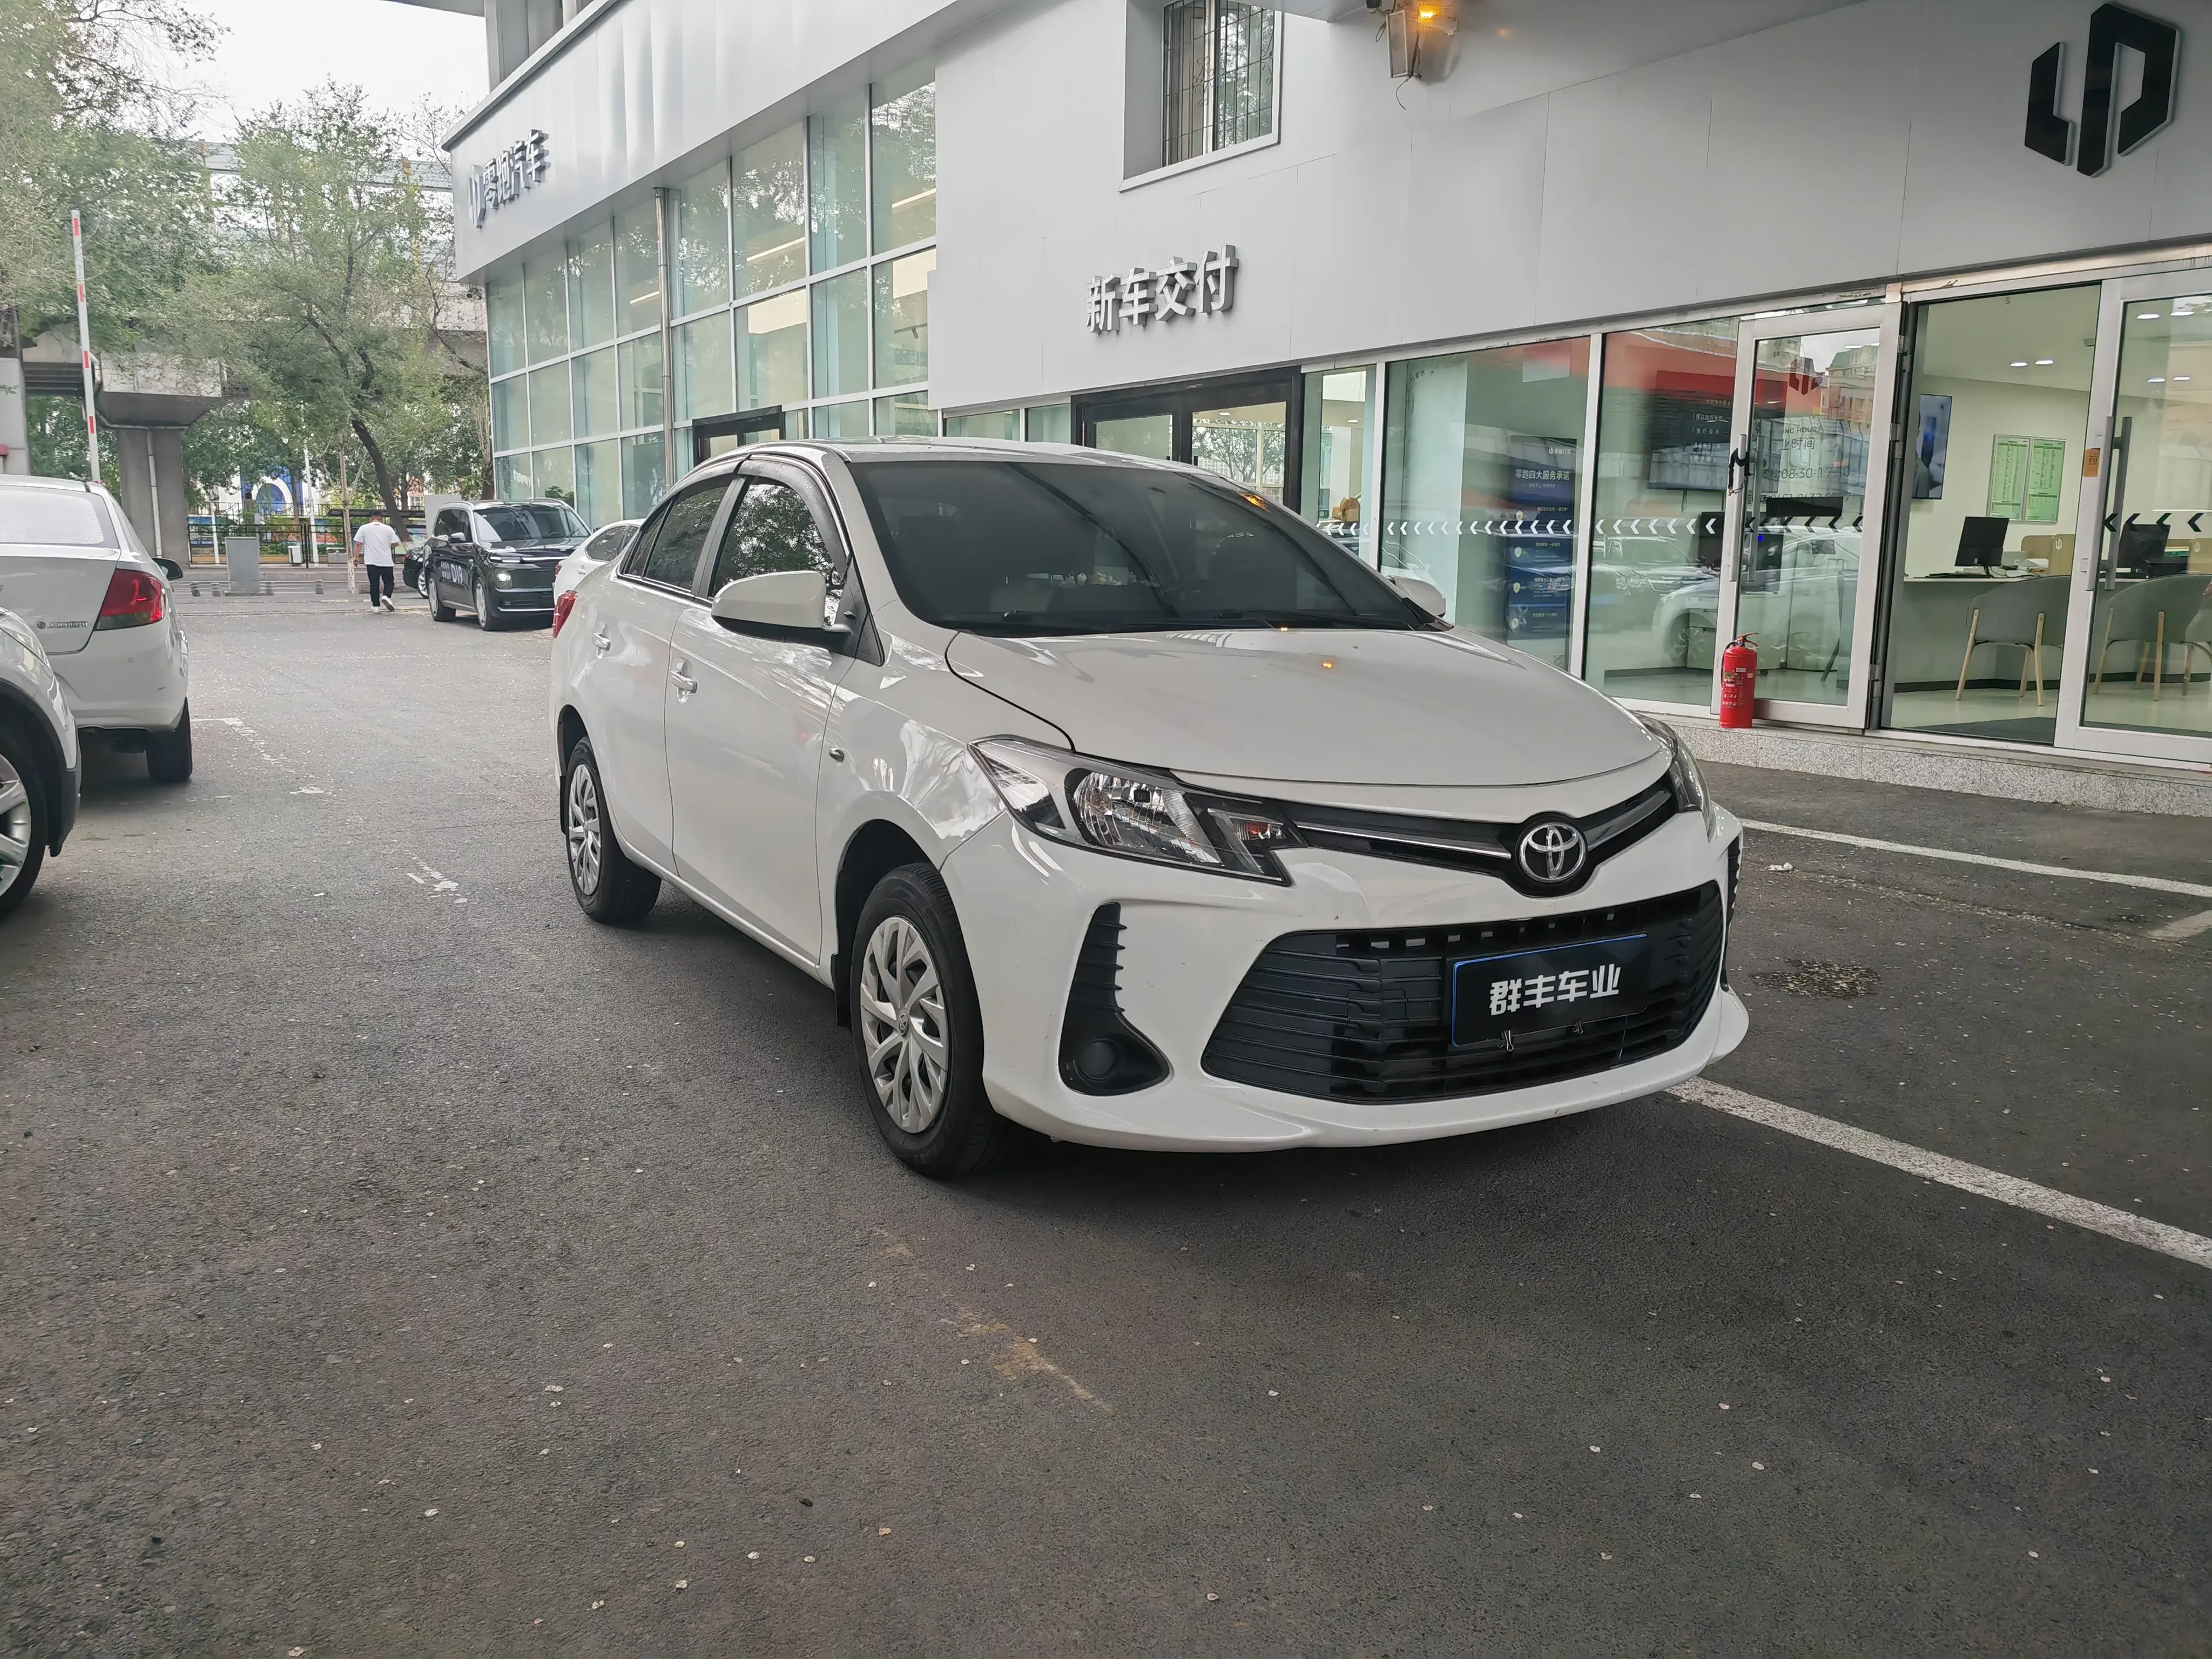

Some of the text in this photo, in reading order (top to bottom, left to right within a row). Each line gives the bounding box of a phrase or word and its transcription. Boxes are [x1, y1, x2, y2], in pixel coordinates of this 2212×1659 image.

[483, 129, 547, 208] 零跑汽车
[1085, 244, 1239, 333] 新车交付
[1515, 469, 1570, 481] 零跑四大服务承诺
[450, 563, 463, 584] D19
[1489, 963, 1622, 1016] 群丰车业
